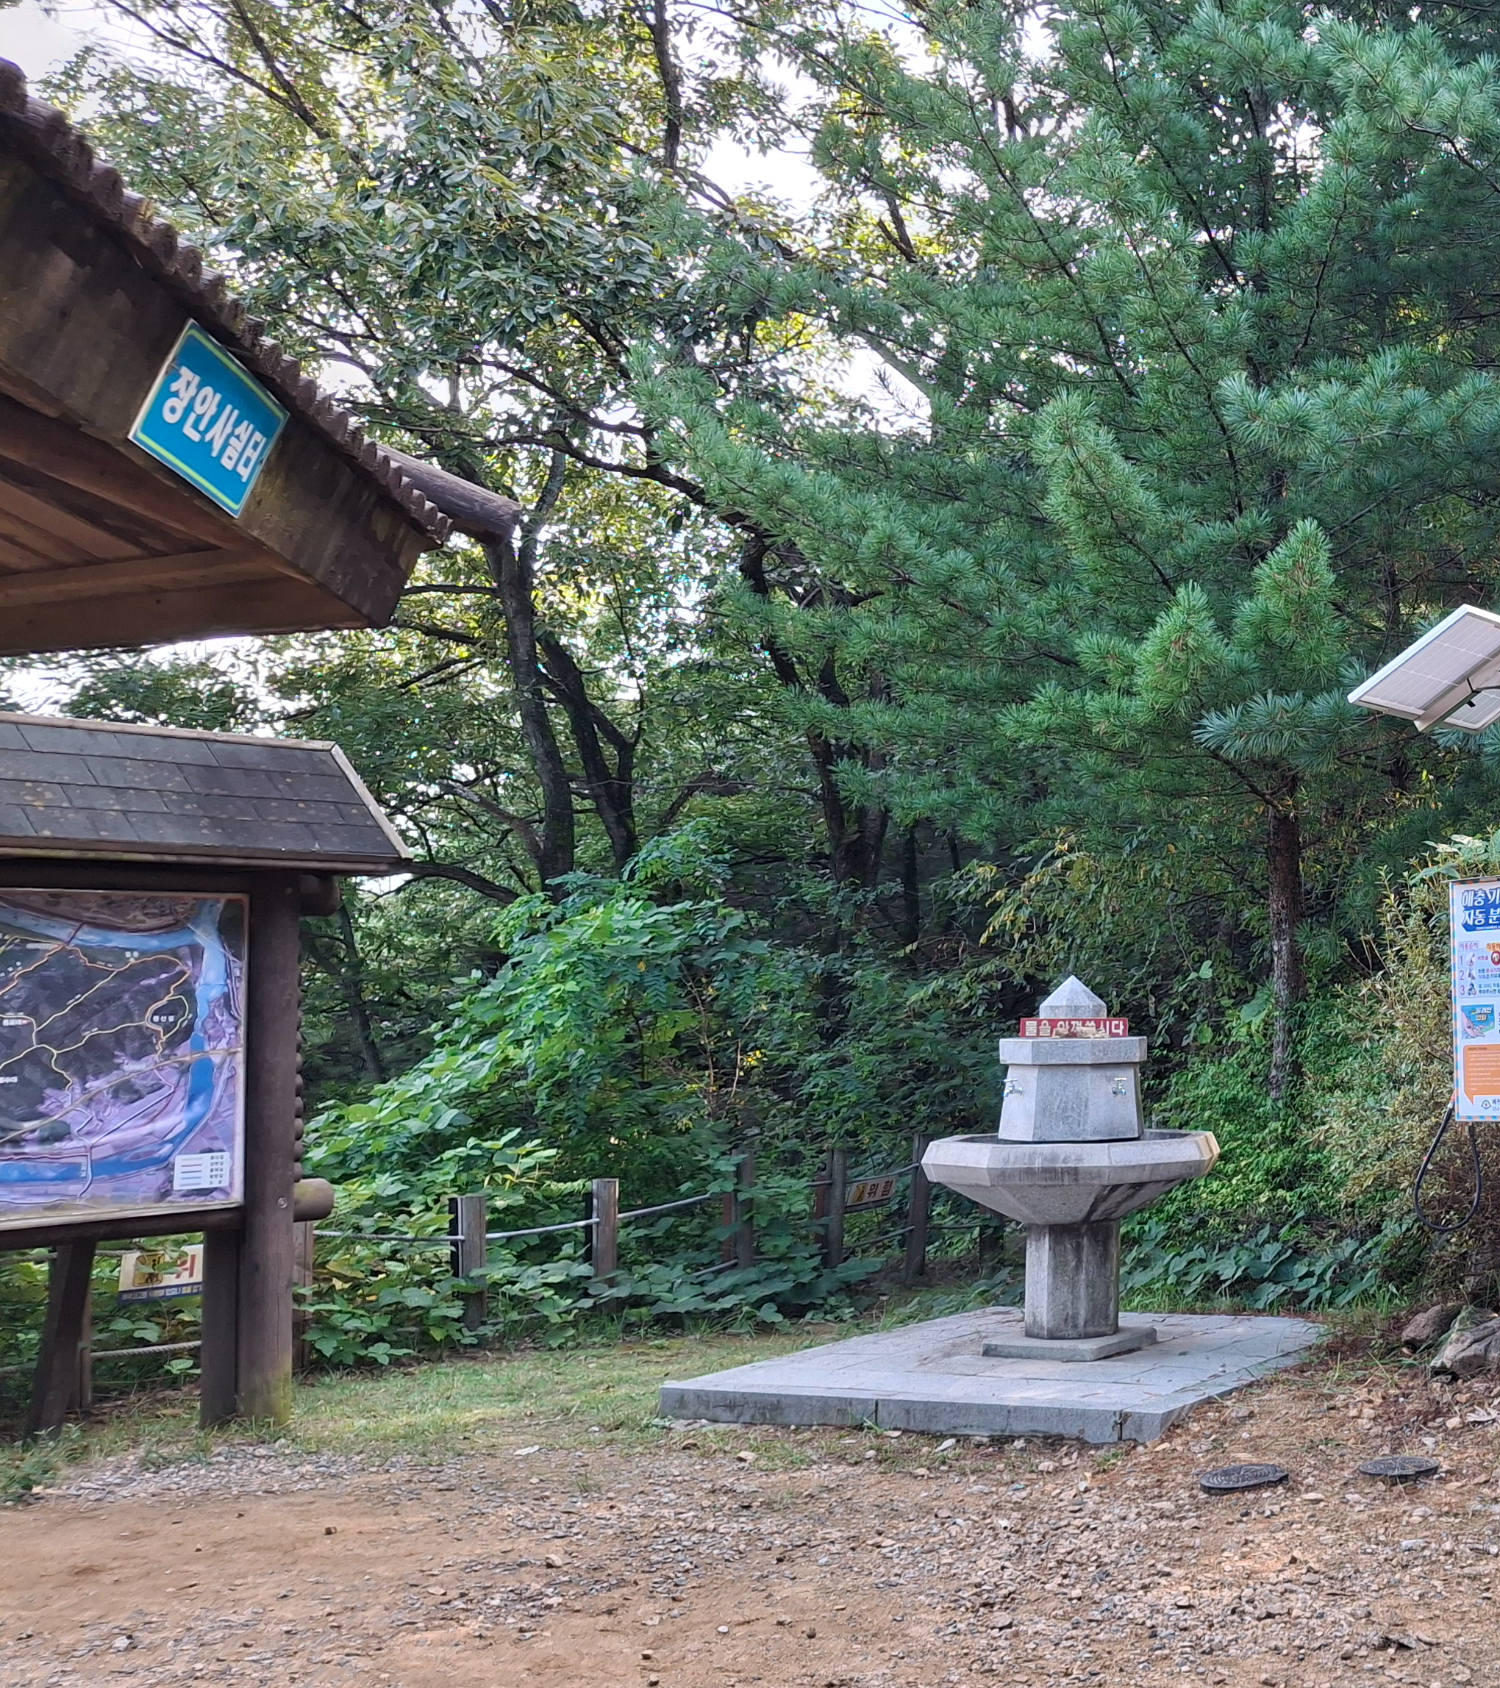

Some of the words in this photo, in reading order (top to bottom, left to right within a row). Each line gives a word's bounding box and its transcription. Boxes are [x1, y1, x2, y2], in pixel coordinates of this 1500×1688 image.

[1462, 908, 1487, 926] 자동
[1459, 969, 1465, 981] 2
[1460, 984, 1466, 996] 3
[1025, 1020, 1051, 1037] 물을
[867, 1179, 894, 1198] 위험
